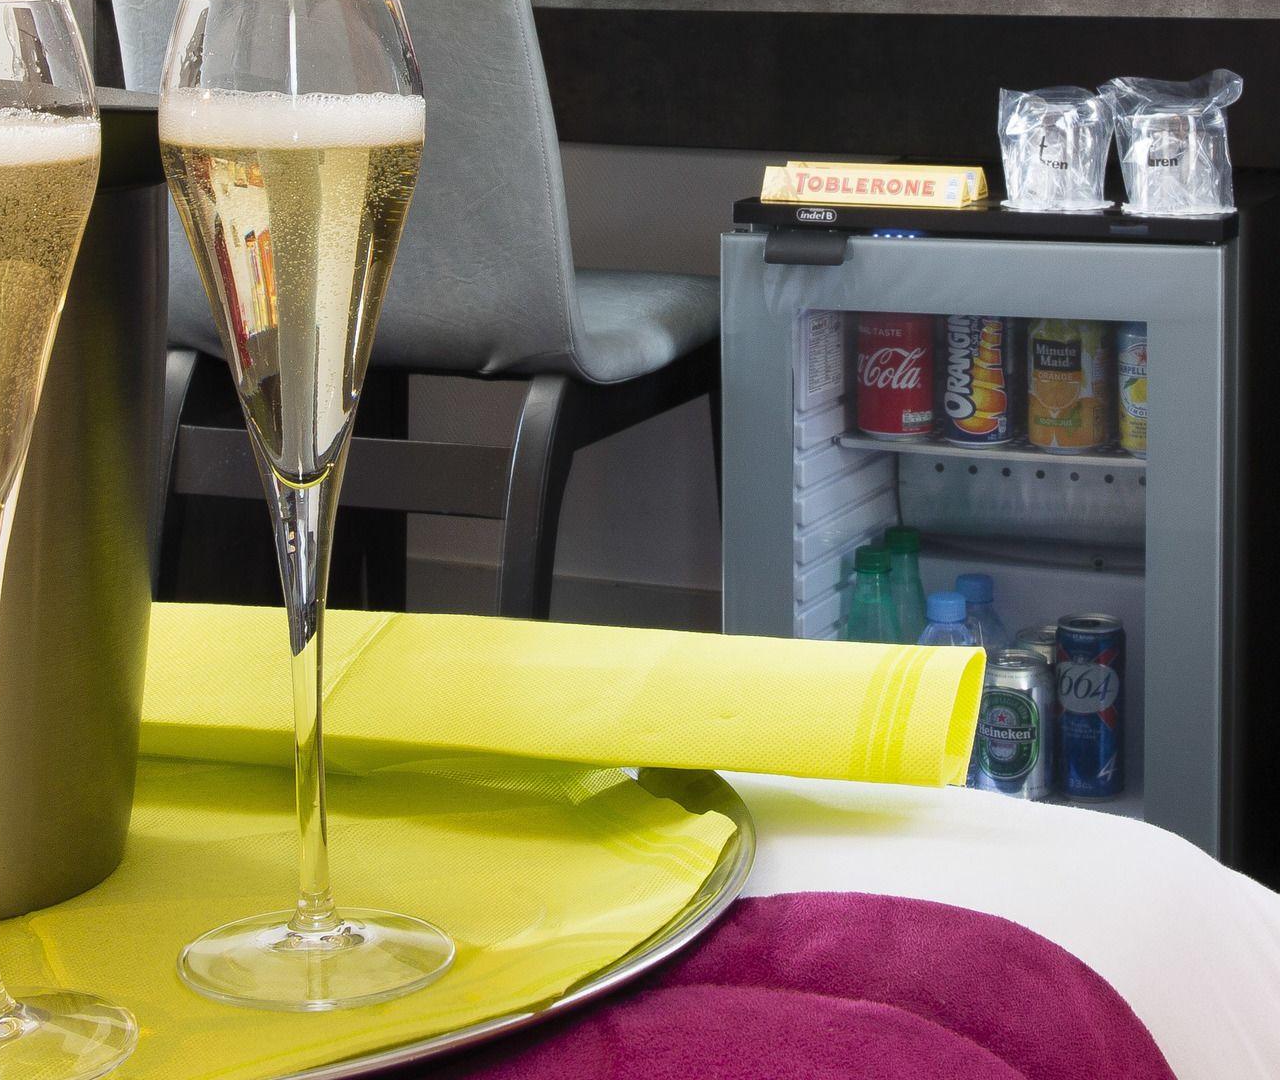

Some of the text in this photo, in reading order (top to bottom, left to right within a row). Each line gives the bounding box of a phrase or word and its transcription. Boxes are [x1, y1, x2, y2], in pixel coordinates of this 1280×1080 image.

[795, 172, 936, 197] TOBLERONE
[800, 210, 825, 220] indel
[873, 327, 903, 337] TASTE
[1036, 343, 1076, 357] Minute
[1040, 356, 1071, 368] Maid
[1039, 372, 1073, 381] ORANGE
[979, 723, 1031, 739] Heineken
